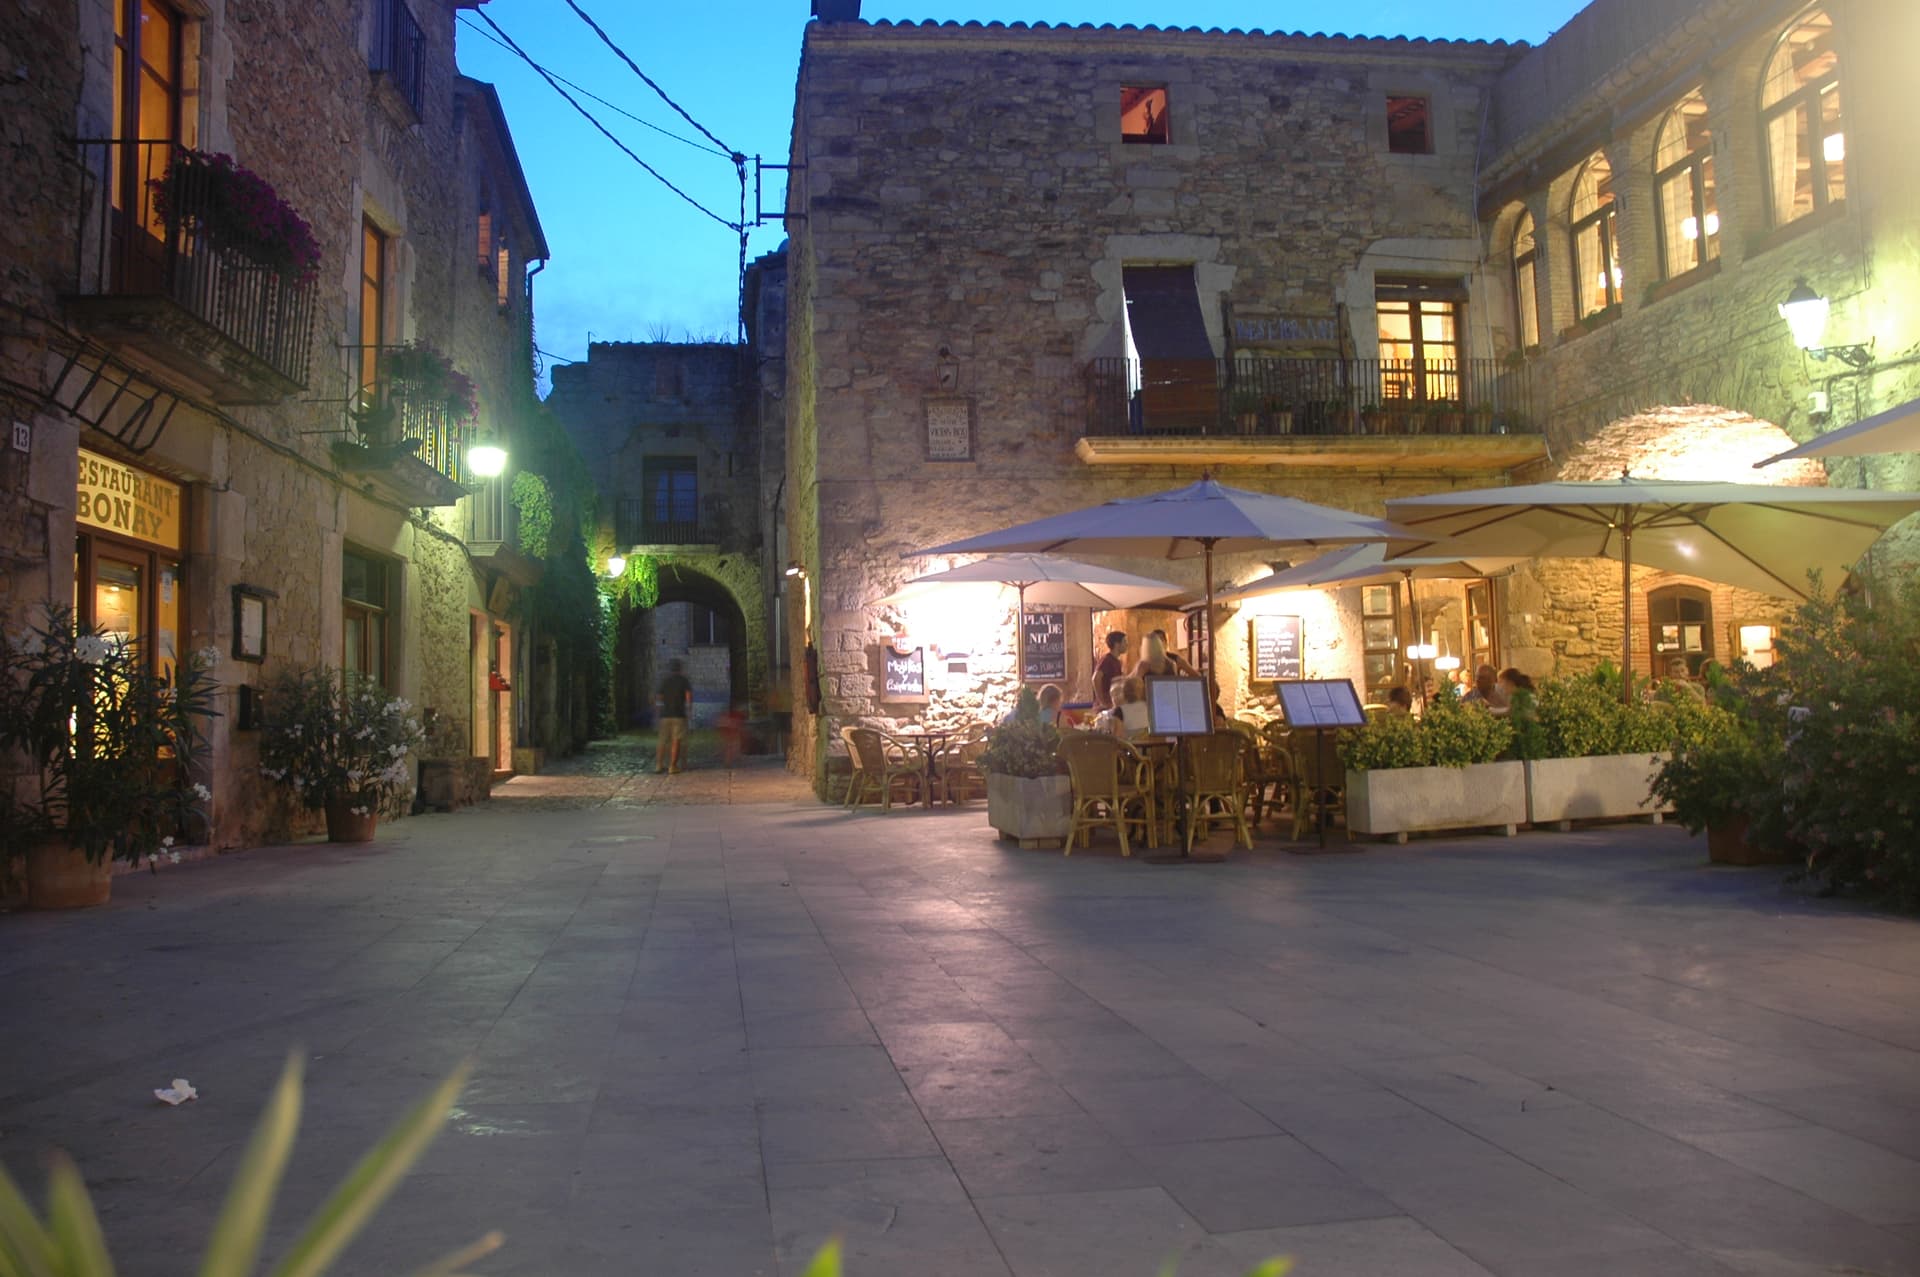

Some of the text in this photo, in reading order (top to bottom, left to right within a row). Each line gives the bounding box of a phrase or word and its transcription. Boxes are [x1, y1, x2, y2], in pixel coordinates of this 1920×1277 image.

[16, 427, 28, 447] 13
[77, 456, 174, 517] ESTAURANT
[77, 490, 162, 539] BONAY
[1024, 614, 1053, 625] PLAT
[1048, 624, 1063, 634] DE
[1029, 633, 1050, 644] NIT
